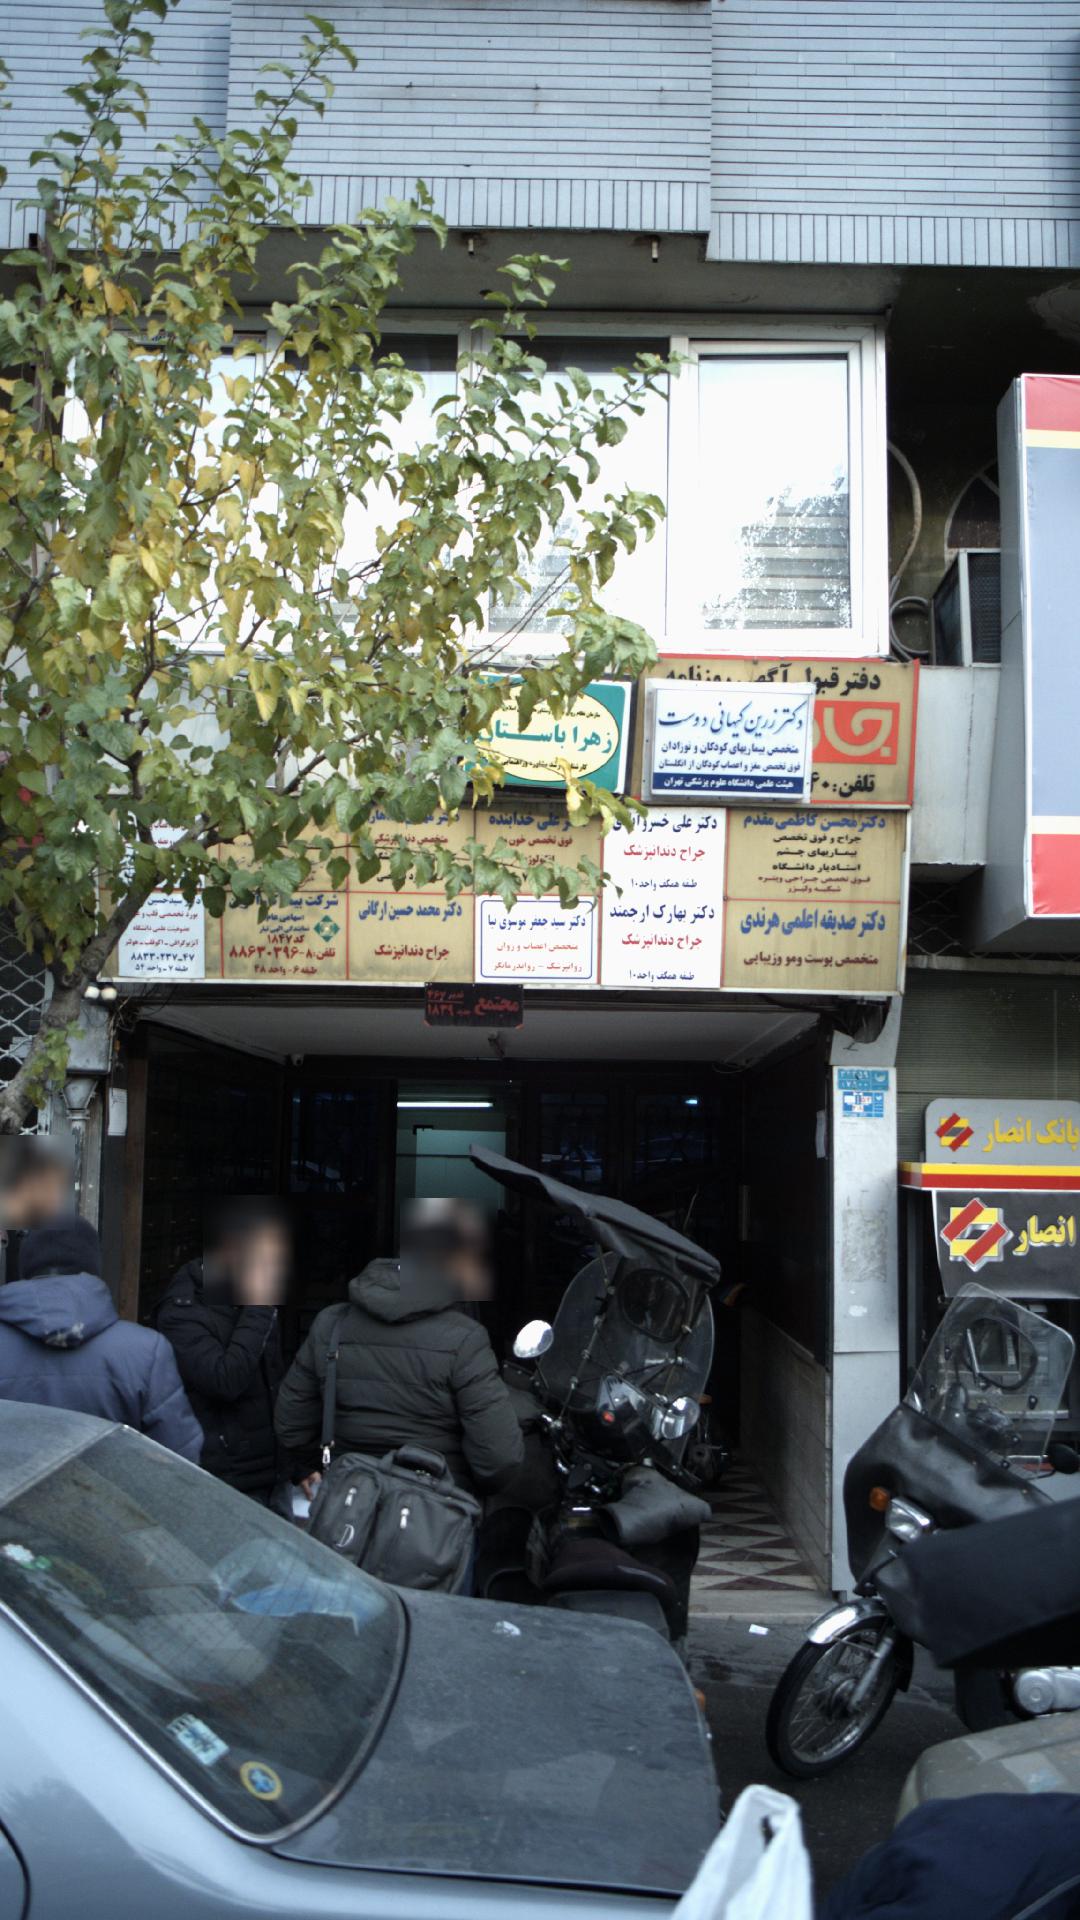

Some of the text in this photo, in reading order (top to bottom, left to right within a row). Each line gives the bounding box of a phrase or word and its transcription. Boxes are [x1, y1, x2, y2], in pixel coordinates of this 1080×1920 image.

[840, 667, 881, 696] دفتر
[658, 700, 808, 738] دکتر زرین کیهانی دوست
[572, 726, 614, 753] زهرا
[661, 741, 691, 754] نوزادان
[700, 741, 728, 754] کودکان
[767, 744, 799, 757] متخصص
[659, 759, 687, 769] انگلستان
[696, 760, 720, 771] کودکان
[721, 761, 743, 769] اعصاب
[750, 761, 761, 773] مغز
[763, 762, 787, 773] تخصص
[787, 763, 801, 773] فوق
[663, 777, 684, 787] تهران
[684, 777, 710, 789] پزشکی
[710, 778, 727, 788] علوم
[728, 778, 754, 787] دانشگاه
[755, 779, 774, 789] علمی
[488, 810, 535, 829] خدابنده
[537, 811, 560, 830] علی
[672, 814, 692, 833] علی
[695, 816, 718, 833] دکتر
[743, 811, 886, 833] دکتر محسن کاظمی مقدم
[417, 835, 448, 845] متخصص
[508, 834, 526, 846] خون
[528, 835, 557, 846] تخصص
[557, 837, 573, 847] فوق
[772, 833, 808, 843] تخصص
[809, 834, 827, 844] فوق
[837, 834, 862, 844] جراح
[623, 844, 706, 861] جراح دندانپزشک
[776, 847, 805, 857] چشم
[772, 862, 861, 873] استادیار دانشگاه
[659, 879, 680, 888] همکف
[682, 879, 698, 888] طبقه
[784, 876, 819, 884] جراحی
[821, 876, 849, 884] تخصص
[305, 895, 338, 909] شرکت
[388, 905, 413, 920] حسین
[416, 905, 440, 917] محمد
[442, 901, 462, 921] دکتر
[609, 904, 650, 923] ارجمند
[690, 905, 715, 924] دکتر
[499, 918, 527, 930] موسوی
[529, 918, 548, 931] جعفر
[551, 918, 566, 930] سید
[568, 915, 586, 931] دکتر
[740, 906, 886, 938] دکتر صدیقه اعلمی هرندی
[496, 942, 515, 952] روان
[548, 943, 578, 952] متخصص
[621, 933, 703, 950] جراح دندانپزشک
[375, 944, 450, 960] جراح دندانپزشک
[804, 954, 833, 967] پوست
[834, 954, 879, 967] متخصص
[268, 966, 286, 975] واحد
[301, 966, 317, 974] طبقه
[656, 971, 677, 980] همکف
[679, 971, 695, 981] طبقه
[982, 1116, 1080, 1152] بانک انصار
[1012, 1214, 1077, 1256] انصار
